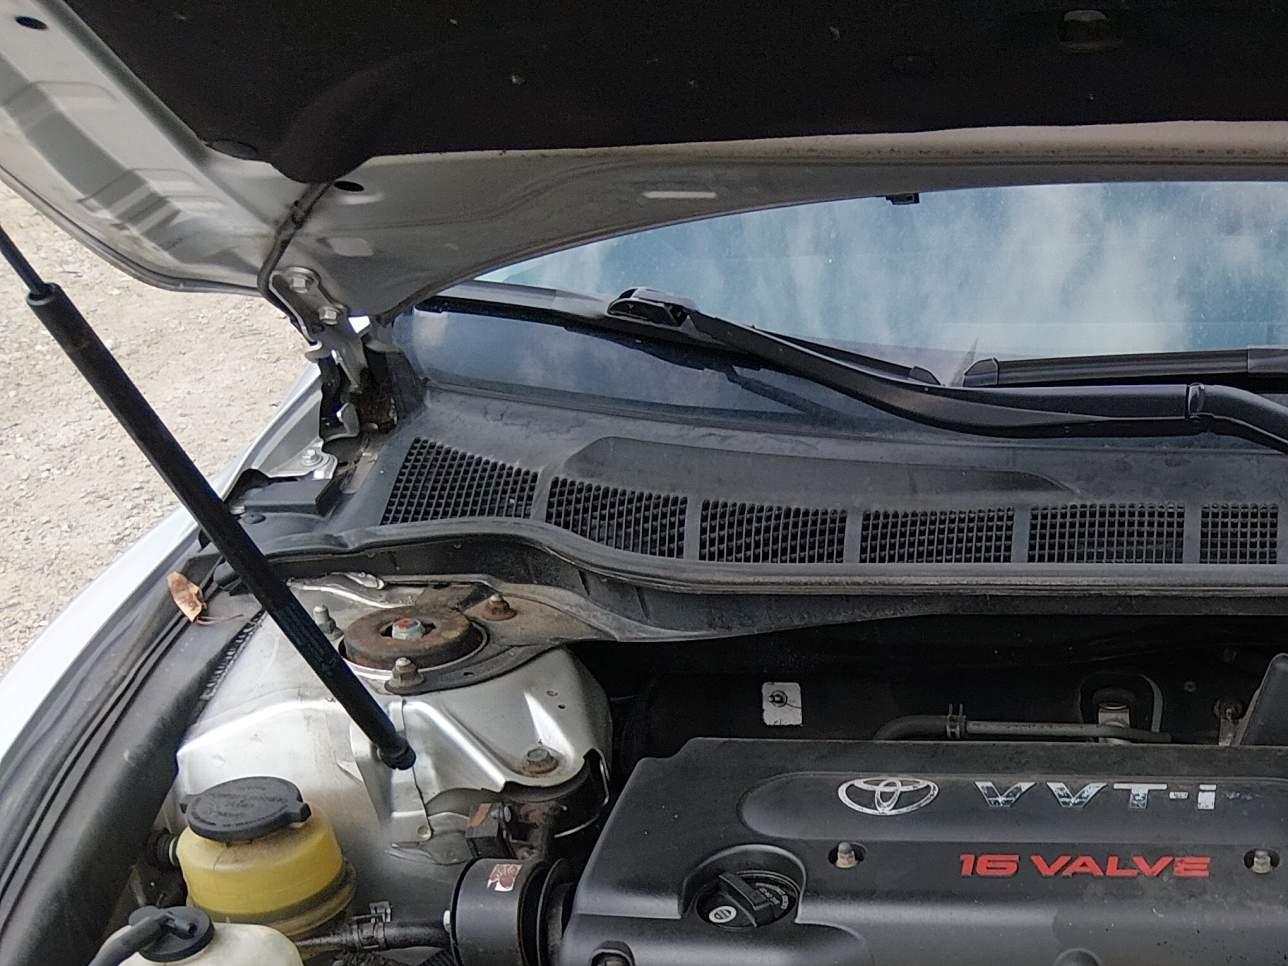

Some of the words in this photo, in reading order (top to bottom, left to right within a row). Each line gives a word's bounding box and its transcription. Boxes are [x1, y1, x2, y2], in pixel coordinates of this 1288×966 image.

[974, 781, 1217, 810] VVT-i
[960, 853, 1020, 877] 16
[1031, 855, 1211, 878] VALVE
